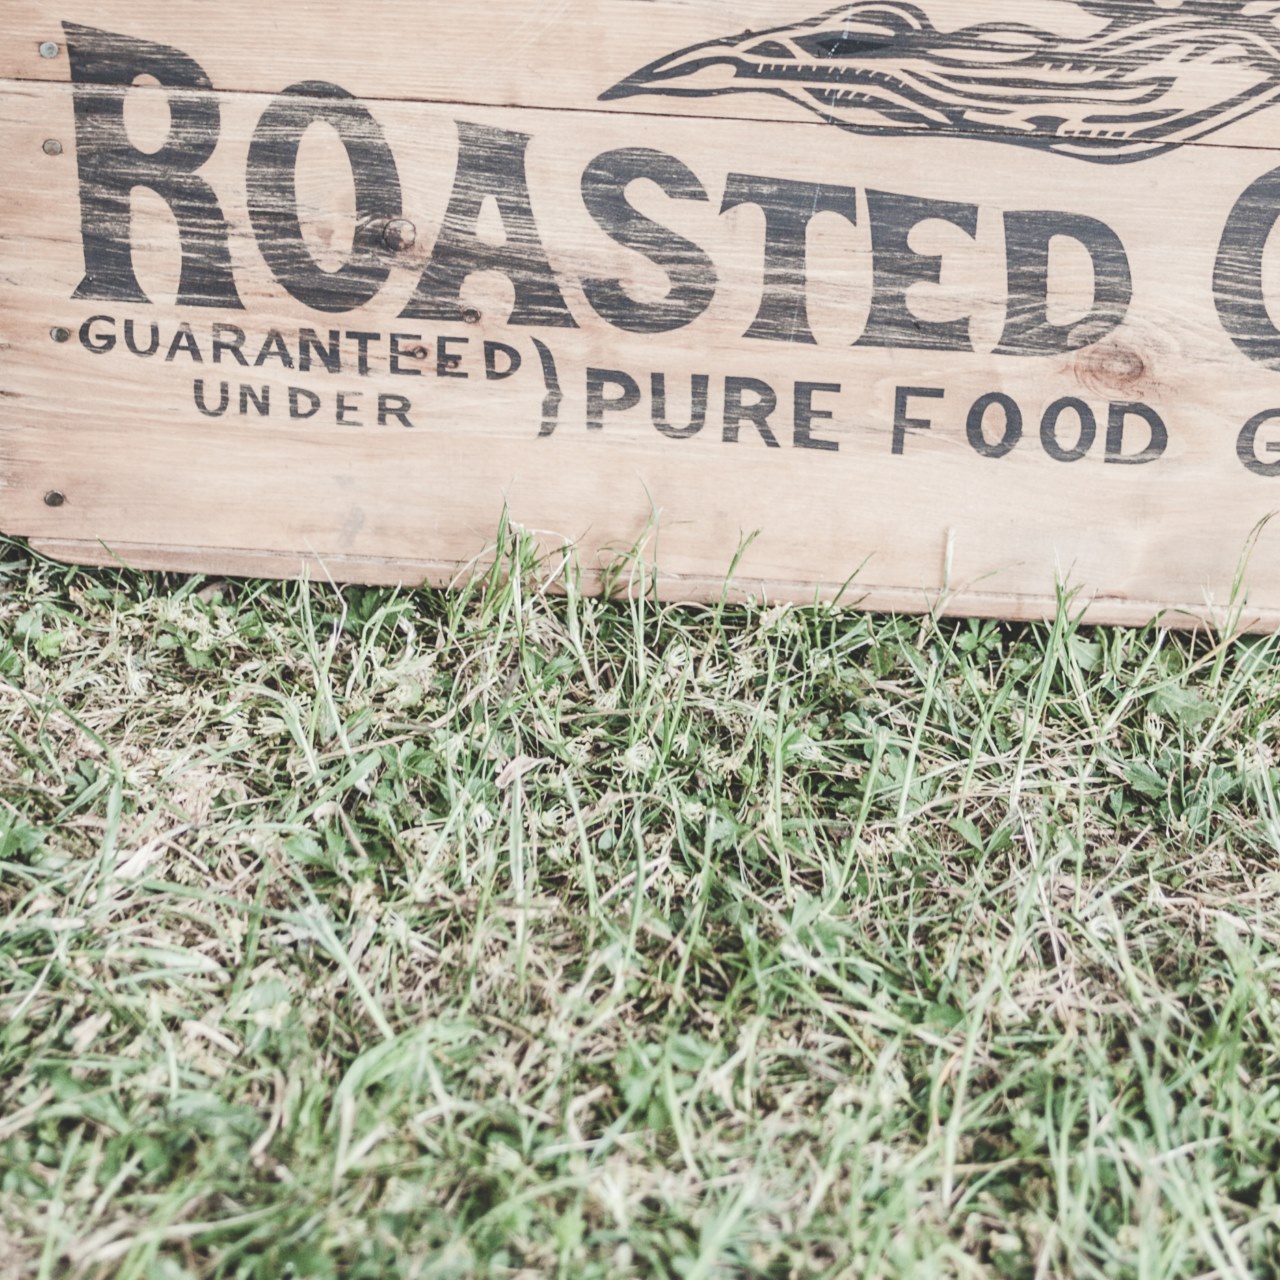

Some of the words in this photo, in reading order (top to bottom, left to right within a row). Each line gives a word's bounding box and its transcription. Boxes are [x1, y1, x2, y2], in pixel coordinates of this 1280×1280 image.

[60, 19, 1134, 357] ROASTED
[77, 314, 523, 382] GUARANTEED
[585, 365, 843, 453] PURE
[890, 384, 1170, 465] FOOD
[193, 378, 416, 428] UNDER
